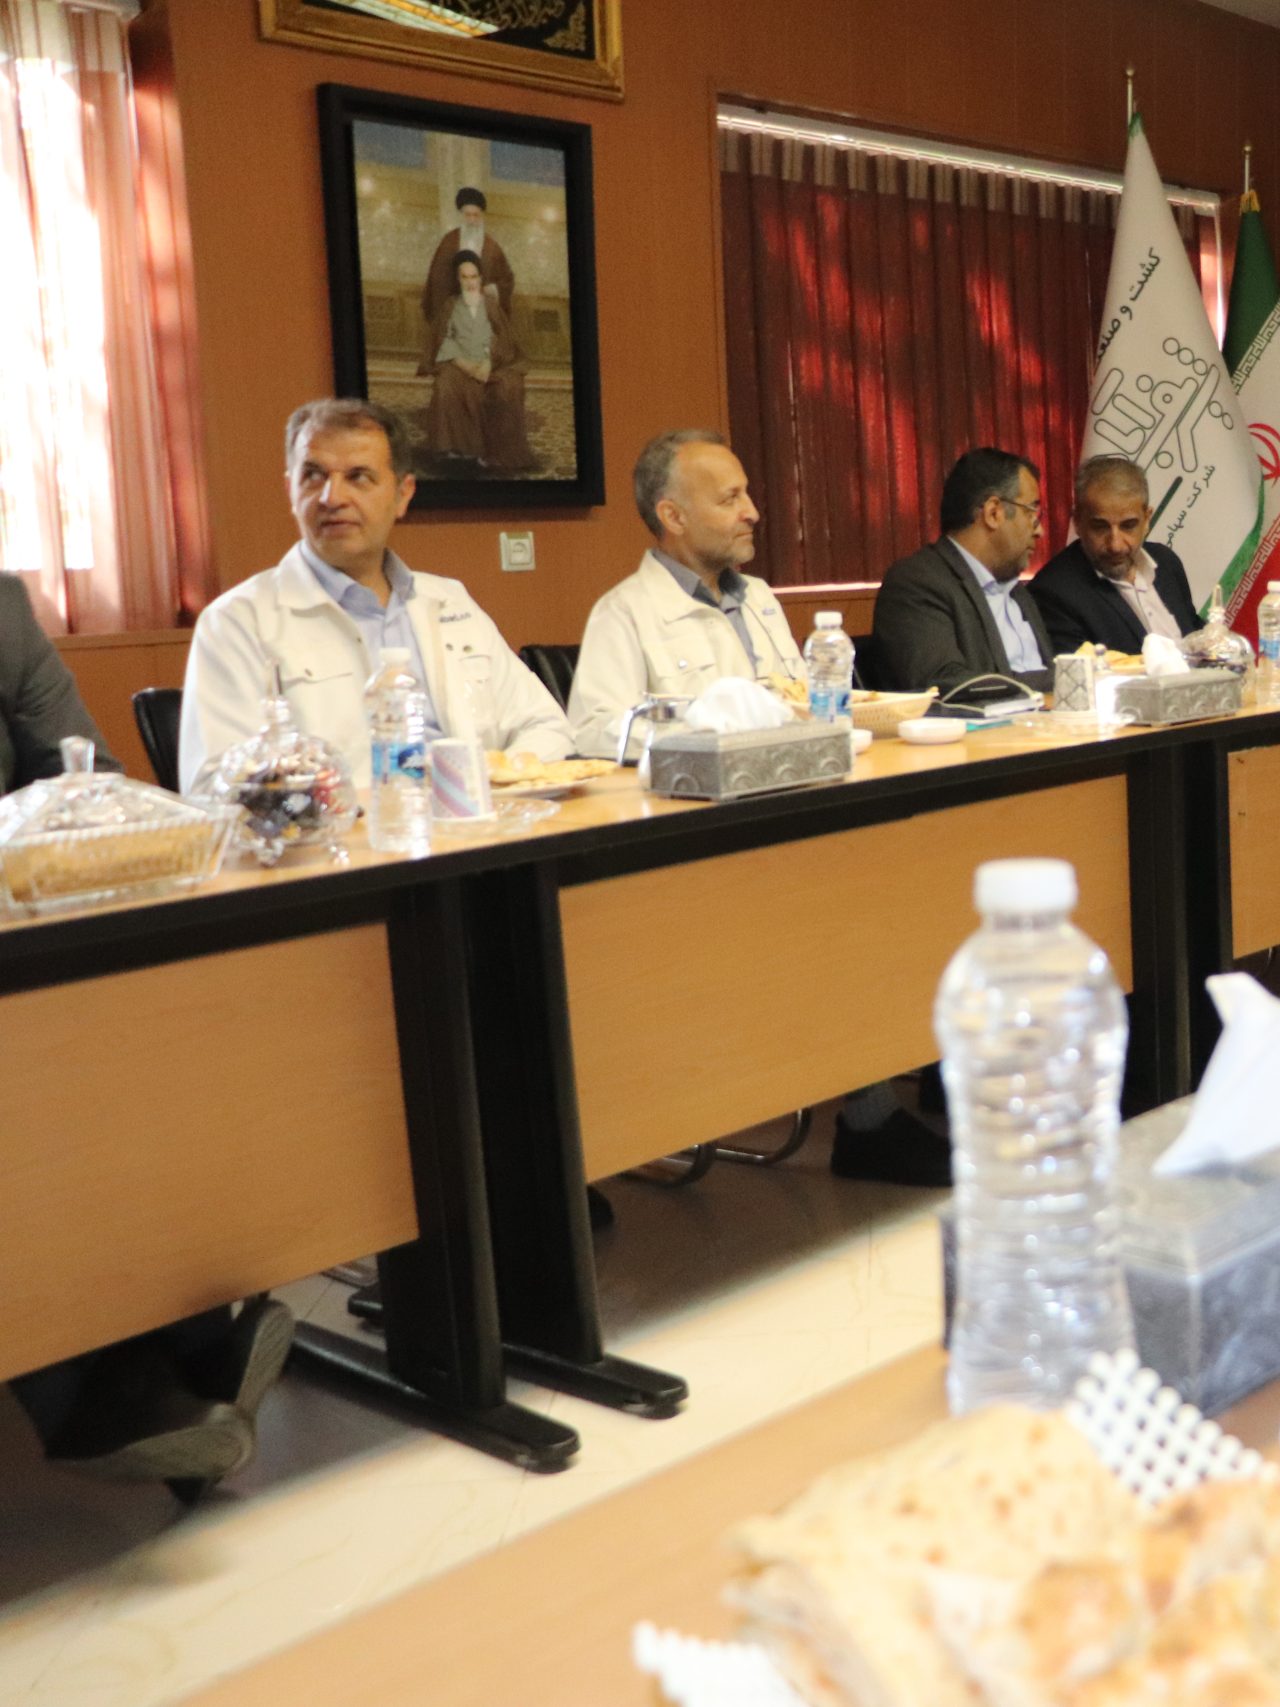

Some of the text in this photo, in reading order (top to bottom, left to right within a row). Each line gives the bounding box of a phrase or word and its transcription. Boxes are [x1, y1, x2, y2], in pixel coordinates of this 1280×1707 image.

[1097, 246, 1160, 360] کشت و صنع
[1186, 465, 1216, 509] شرکت
